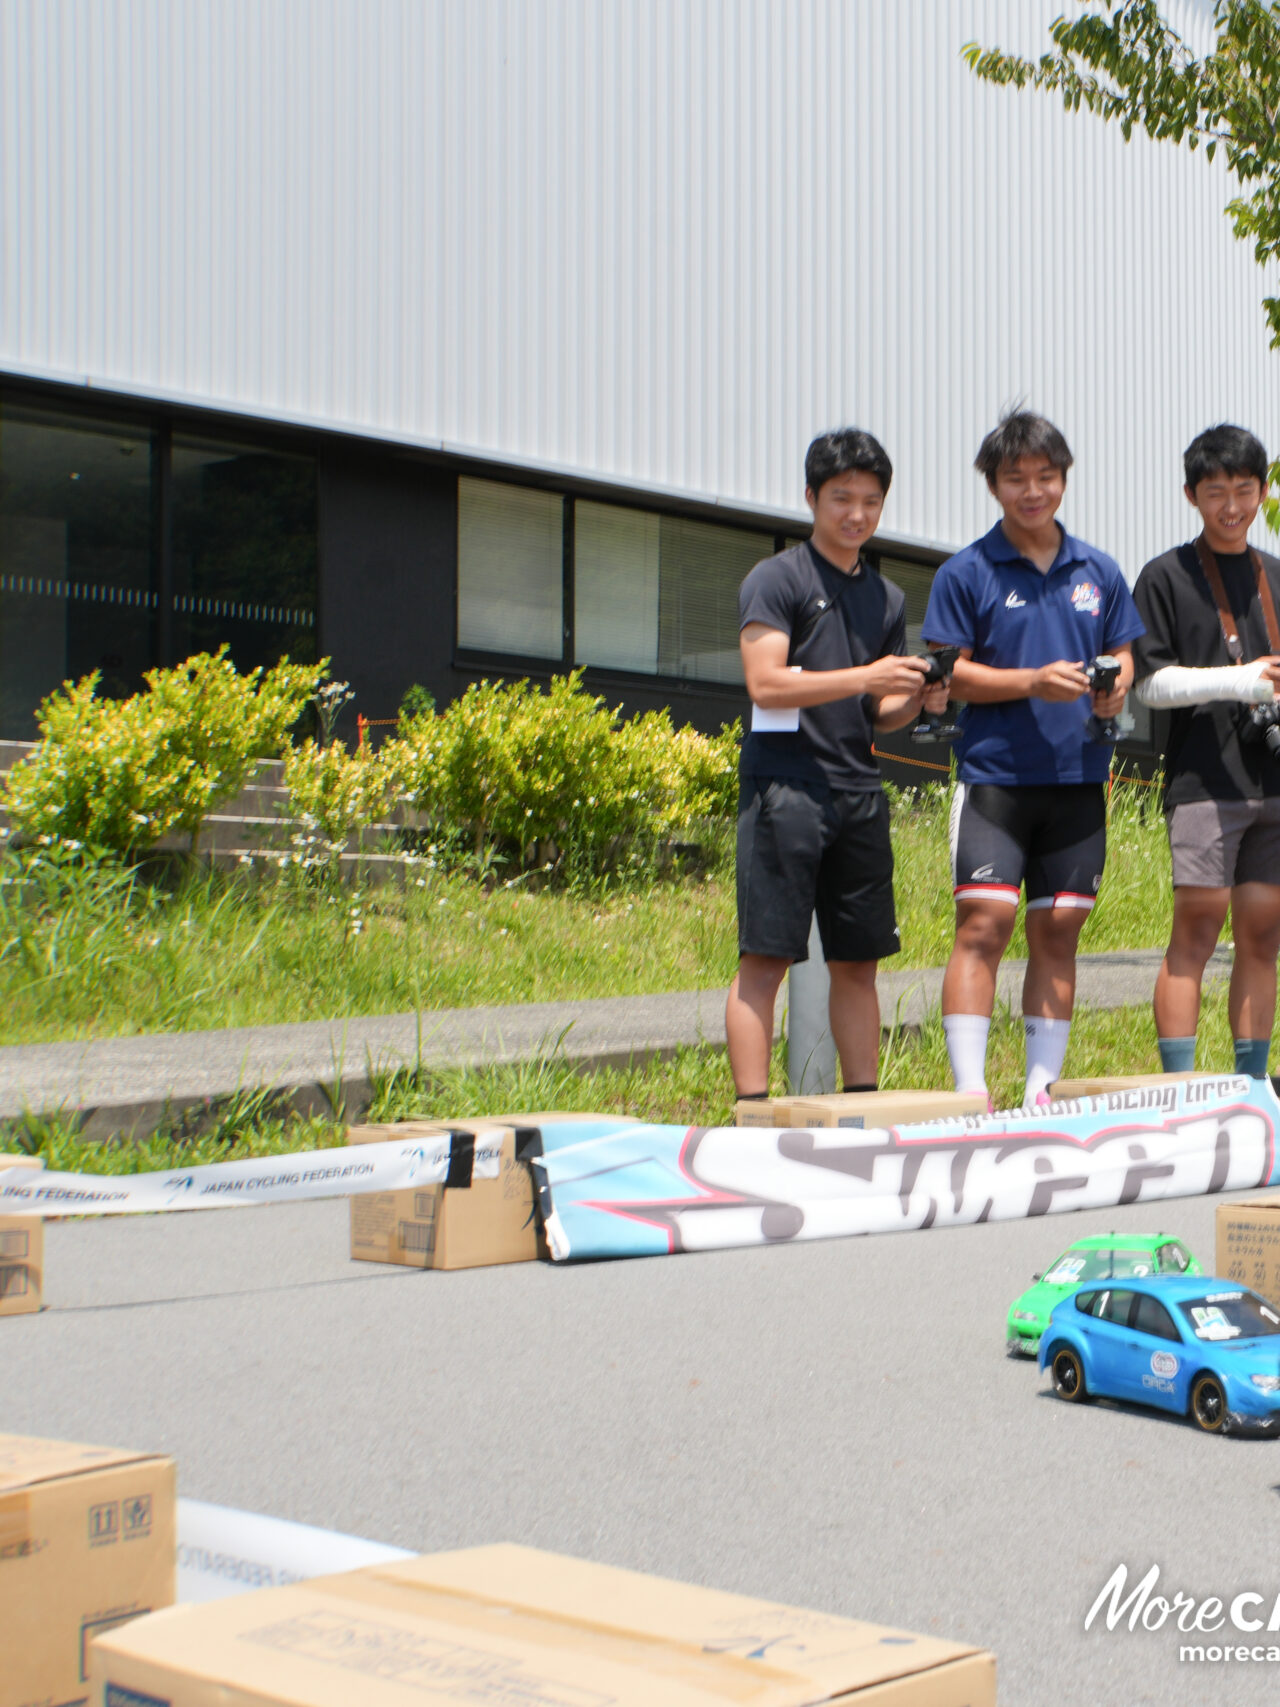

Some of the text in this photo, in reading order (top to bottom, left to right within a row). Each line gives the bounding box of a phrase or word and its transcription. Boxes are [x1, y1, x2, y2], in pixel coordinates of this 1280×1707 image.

[1090, 1086, 1177, 1114] racing
[1184, 1075, 1248, 1103] tires
[35, 1185, 130, 1201] FEDERATION
[201, 1163, 375, 1195] JAPAN CYCLING FEDERATION
